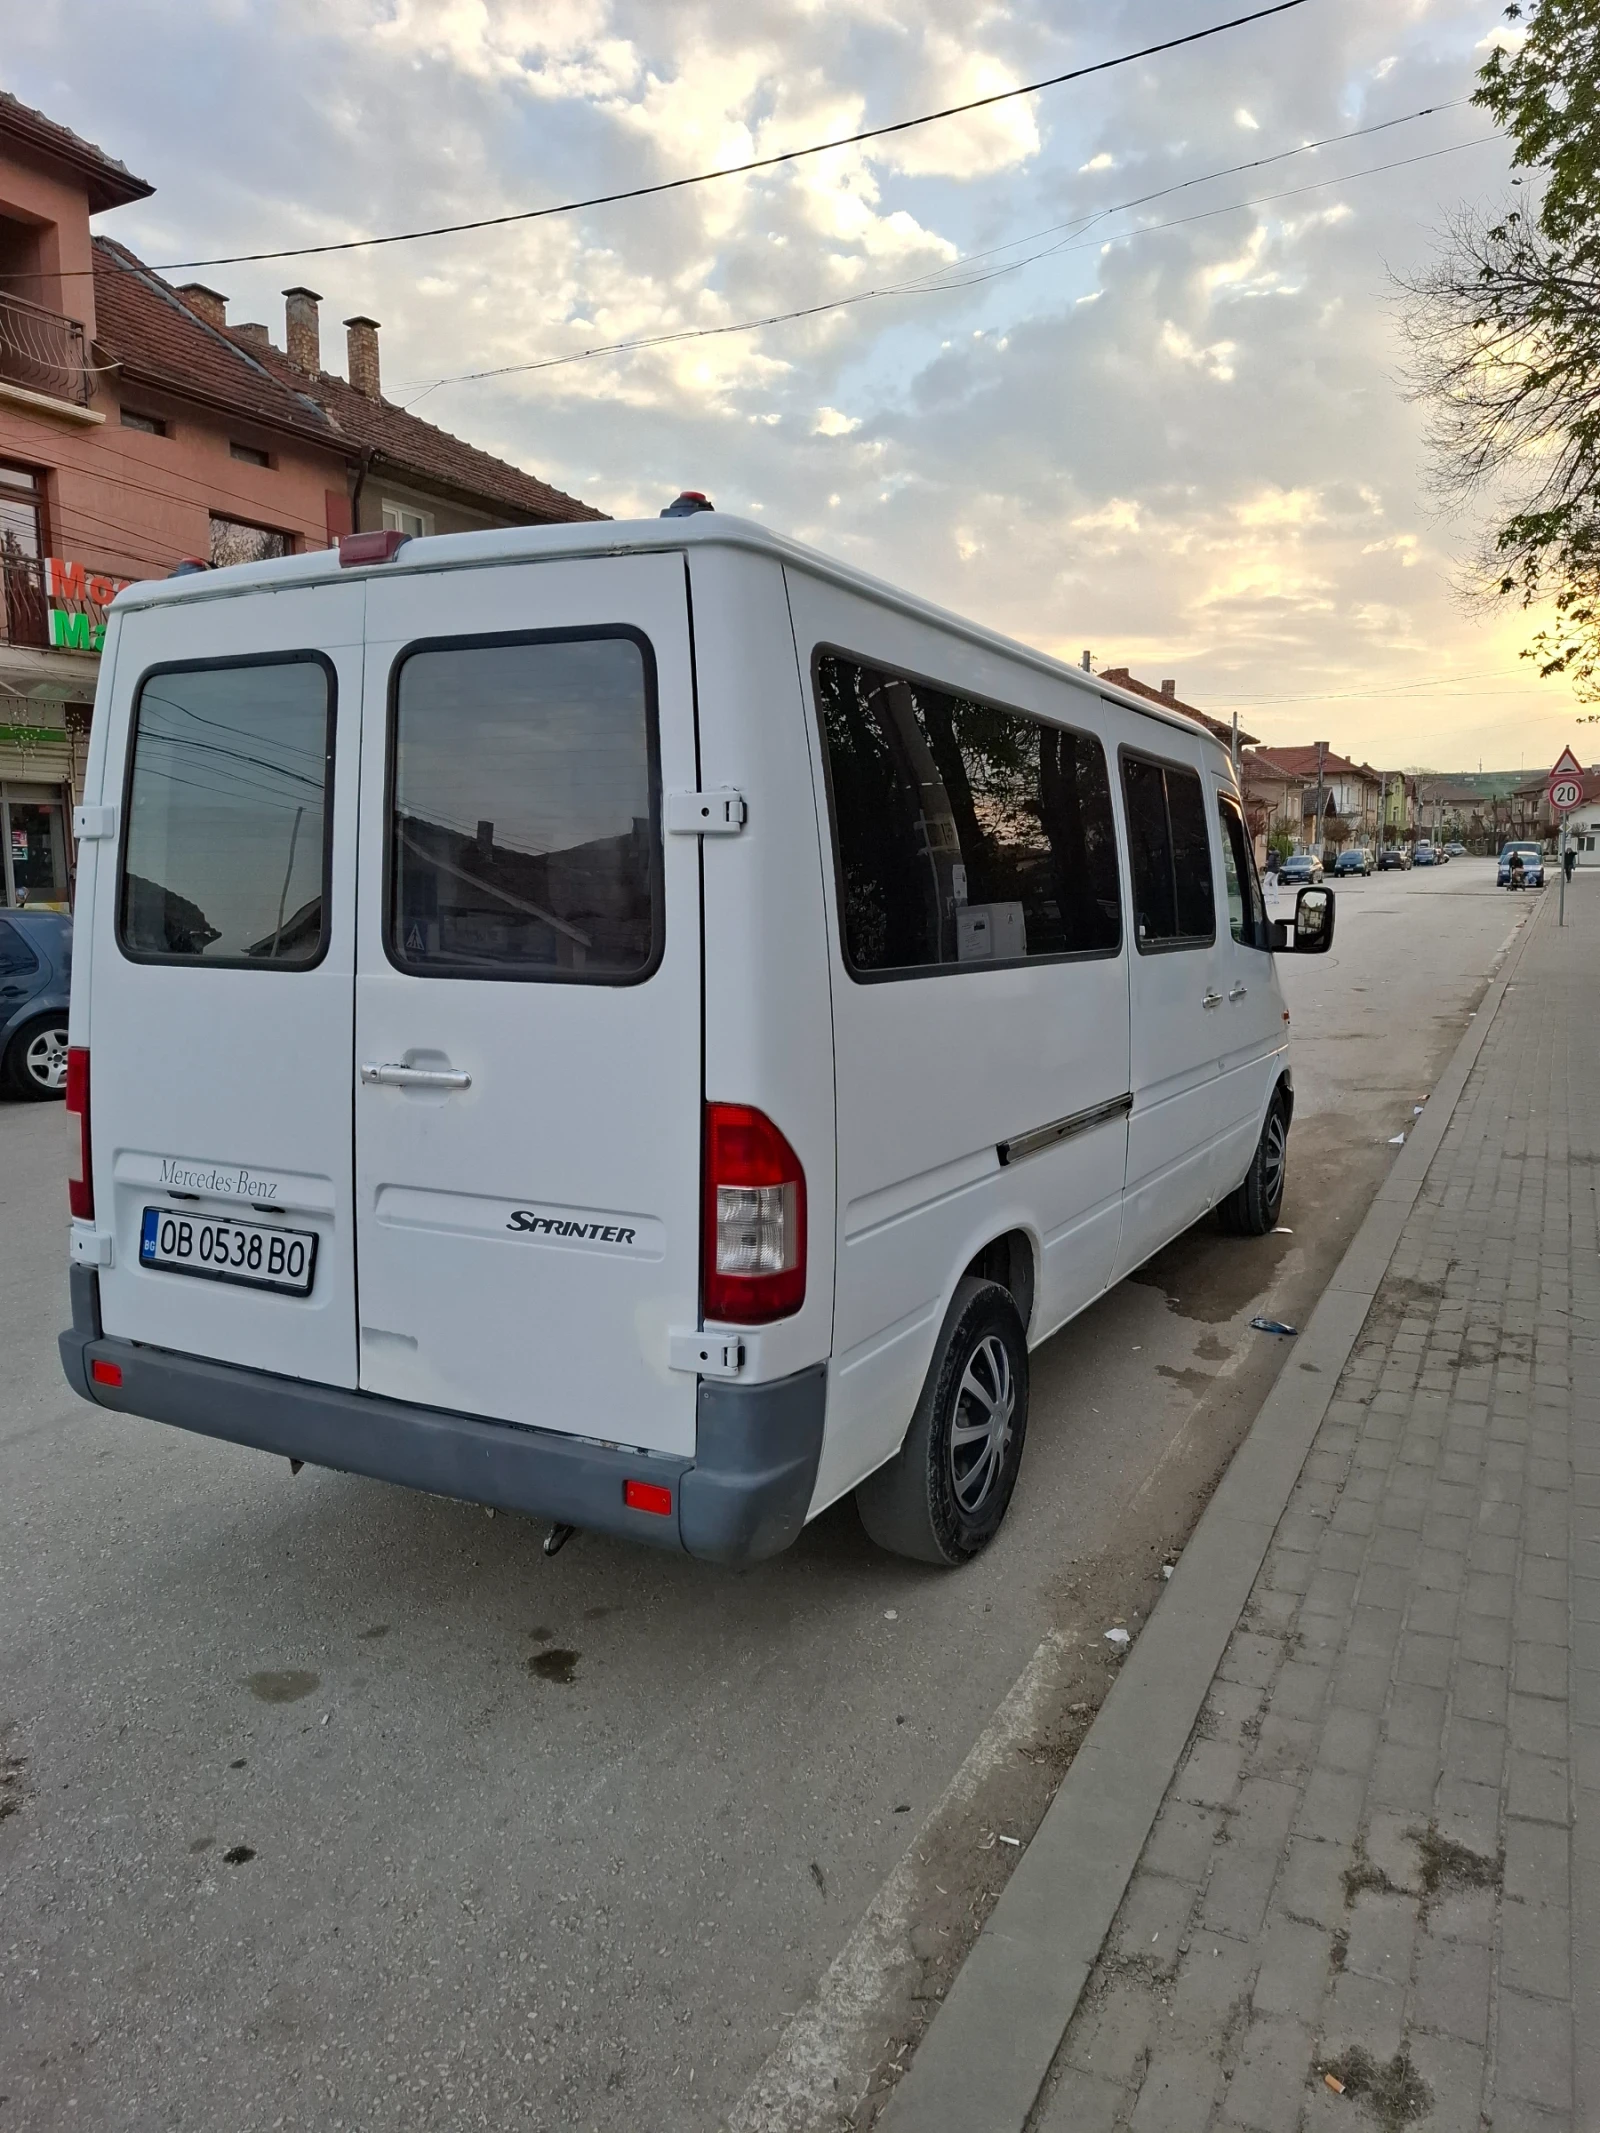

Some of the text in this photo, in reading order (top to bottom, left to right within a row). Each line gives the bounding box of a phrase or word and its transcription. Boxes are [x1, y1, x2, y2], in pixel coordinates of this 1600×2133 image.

[45, 558, 132, 605] Mo
[1557, 786, 1576, 802] 20
[159, 1159, 278, 1199] Mercedes-Benz
[144, 1239, 156, 1252] BG
[160, 1220, 193, 1257] OB
[199, 1226, 263, 1270] 0538
[505, 1210, 636, 1244] SPRINTER
